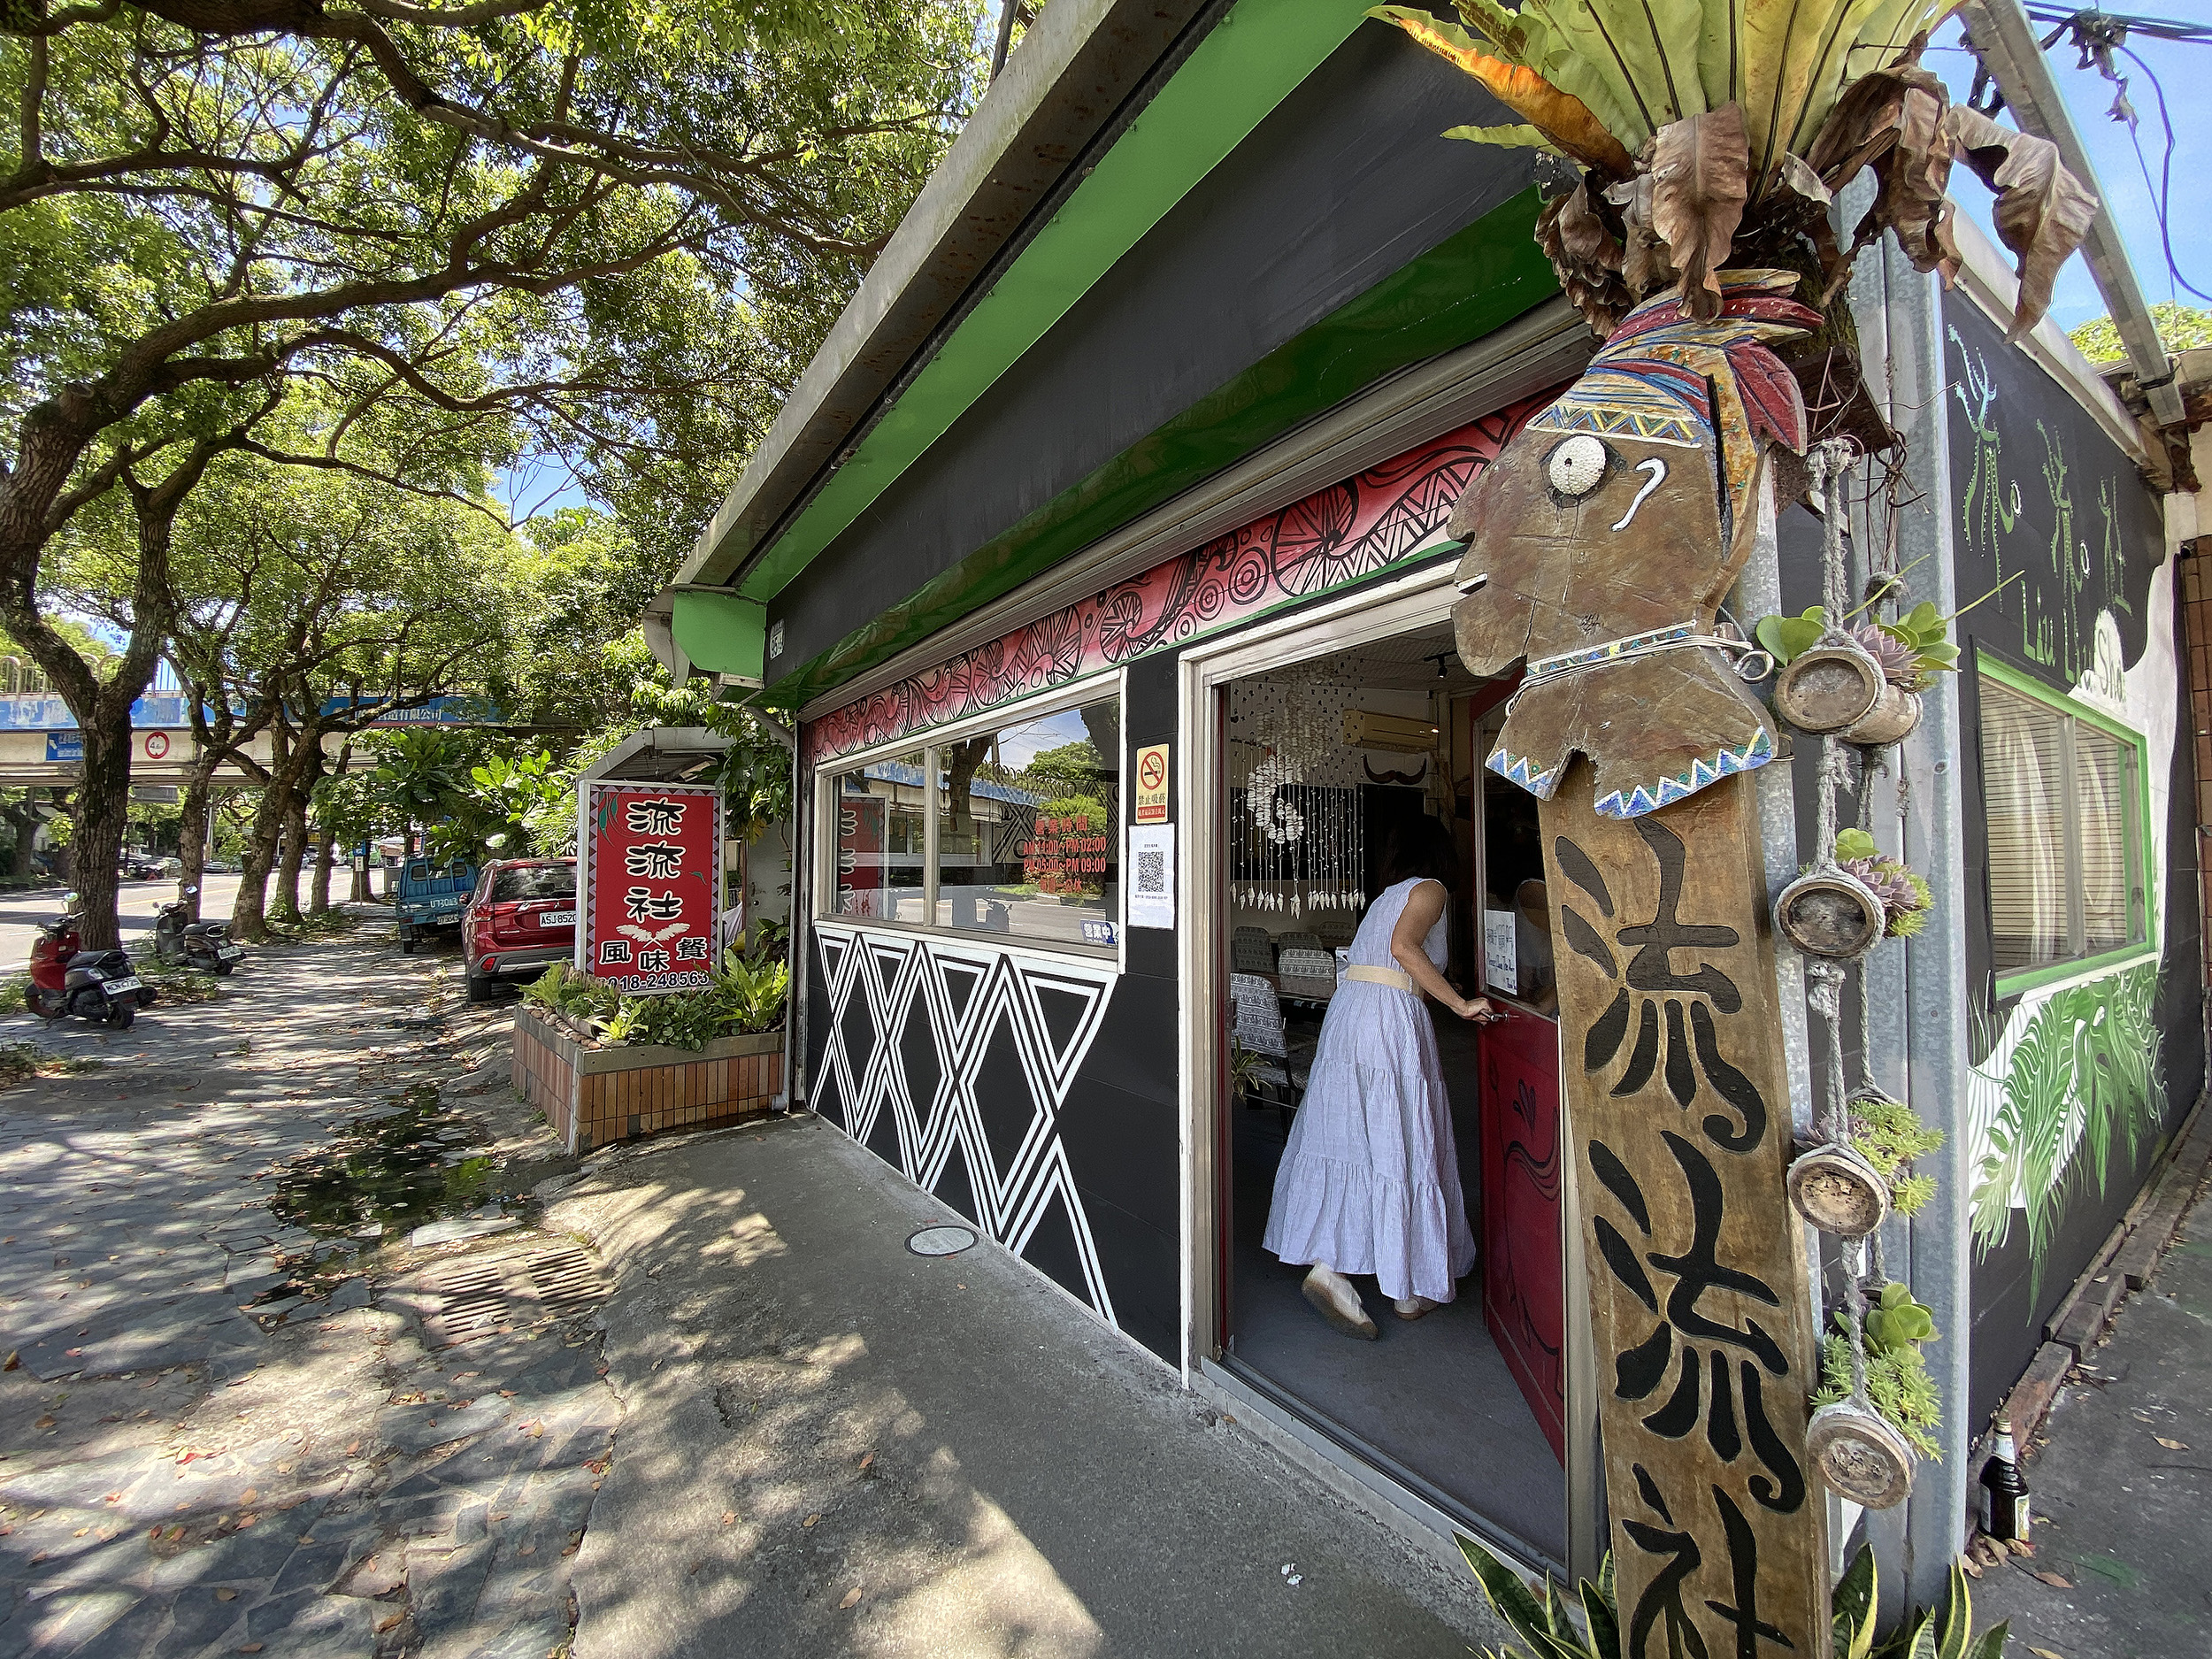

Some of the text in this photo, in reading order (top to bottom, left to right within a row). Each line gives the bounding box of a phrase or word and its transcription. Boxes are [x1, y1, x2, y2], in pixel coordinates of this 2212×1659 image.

[1035, 816, 1087, 834] 營業時間
[624, 797, 687, 924] 流流社
[1080, 857, 1107, 872] 09:00
[599, 937, 708, 972] 風味餐
